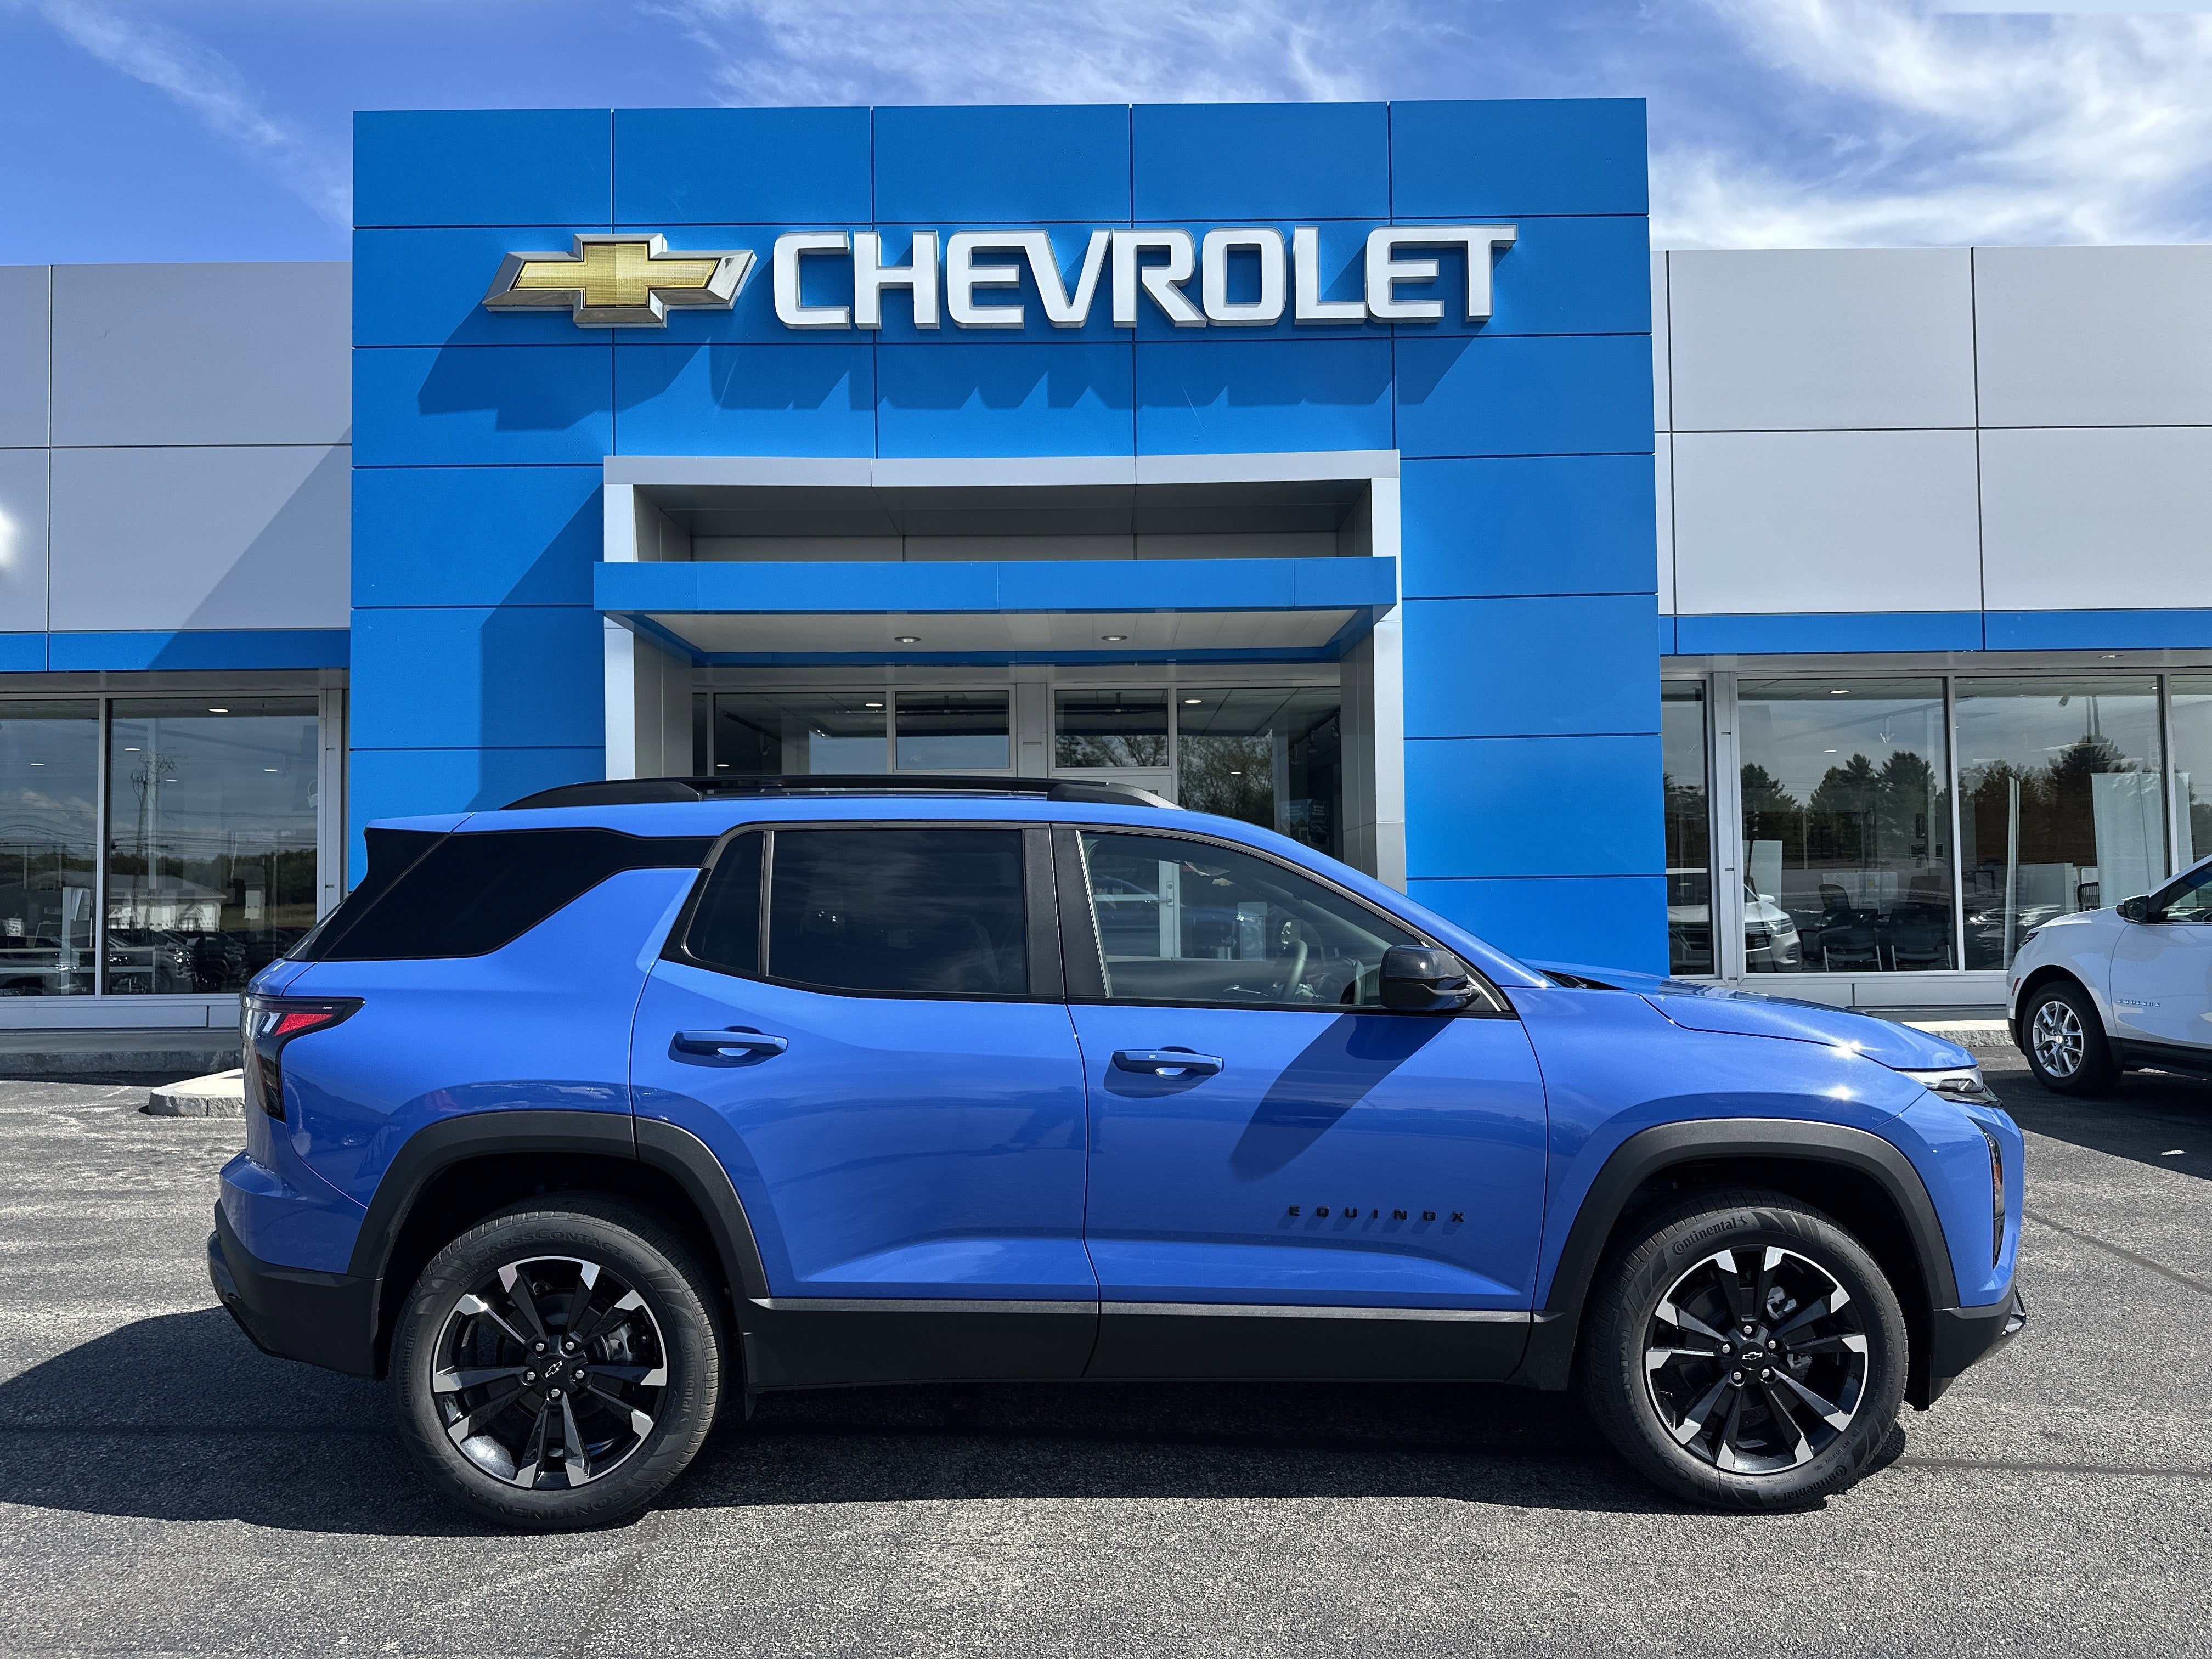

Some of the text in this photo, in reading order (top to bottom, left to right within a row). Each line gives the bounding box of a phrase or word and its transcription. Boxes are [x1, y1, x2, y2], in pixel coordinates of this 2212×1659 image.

[772, 224, 1518, 331] CHEVROLET
[1288, 1205, 1465, 1223] EQUINOX
[1672, 1217, 1737, 1256] Continental
[399, 1334, 416, 1408] Continental
[681, 1338, 698, 1413] Continental
[1784, 1465, 1848, 1502] Continental
